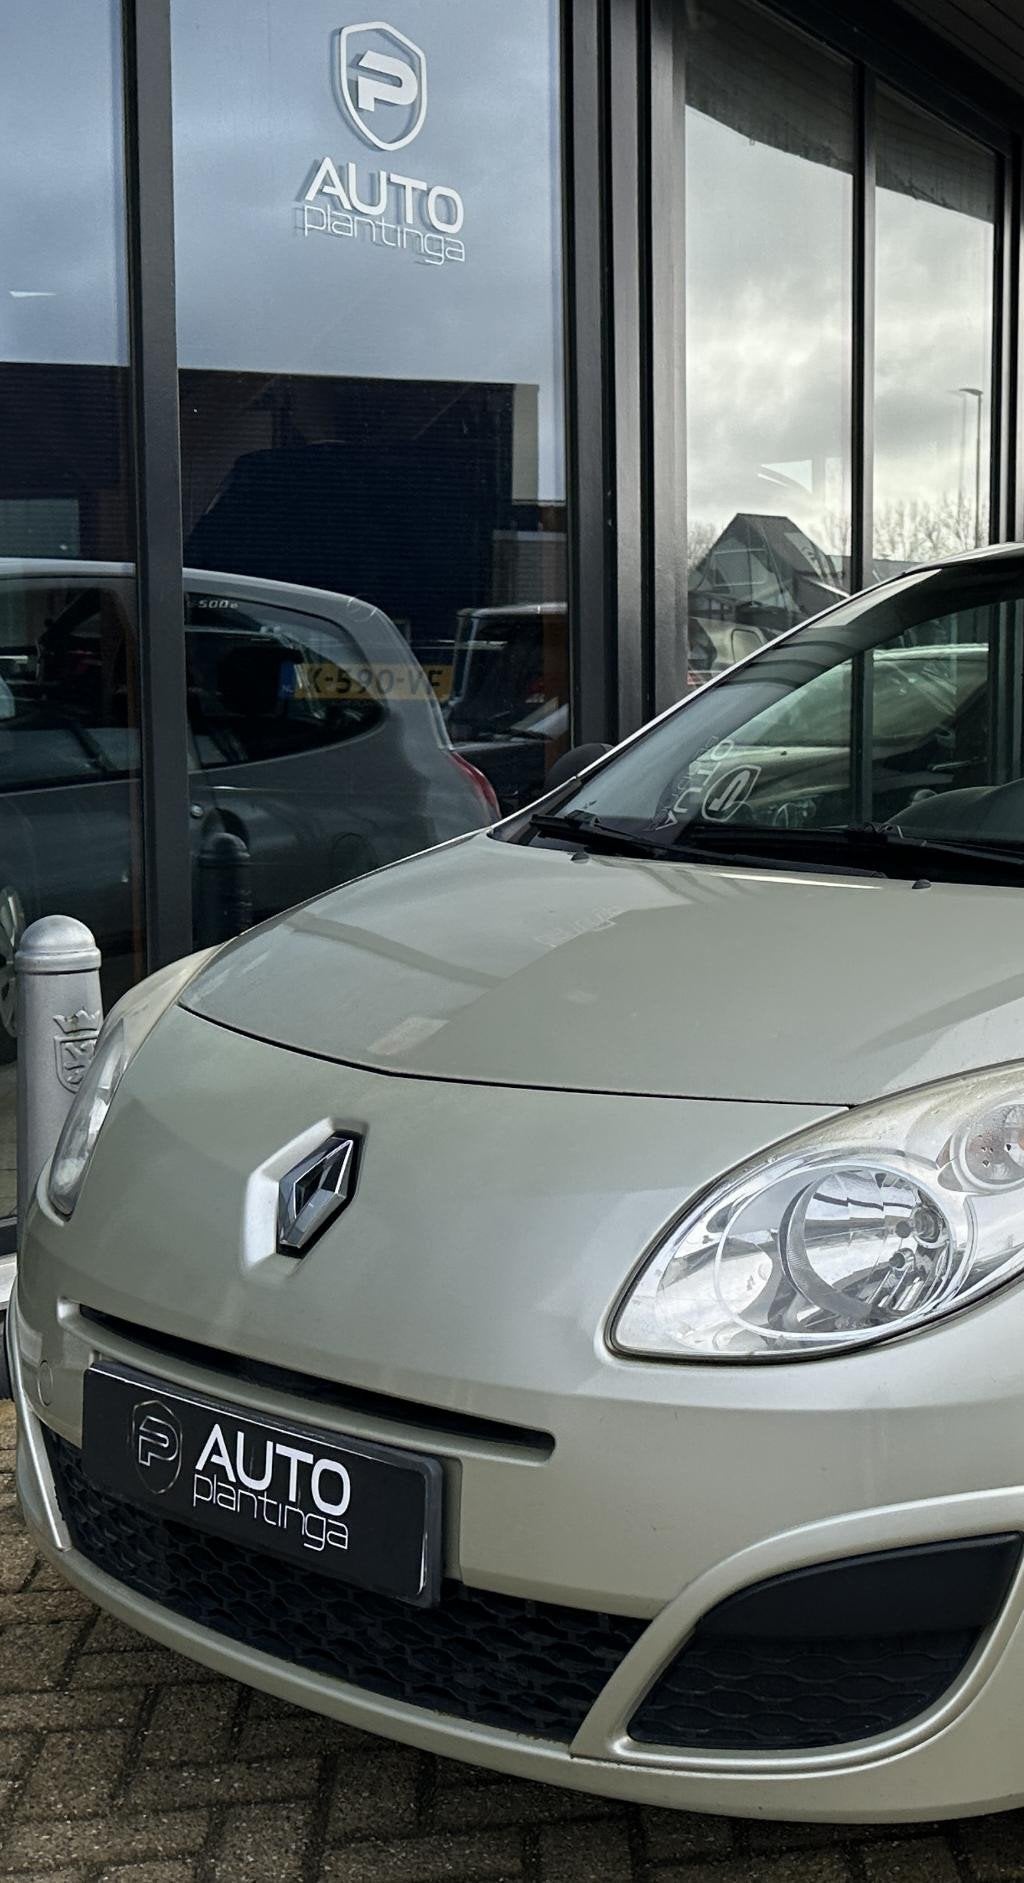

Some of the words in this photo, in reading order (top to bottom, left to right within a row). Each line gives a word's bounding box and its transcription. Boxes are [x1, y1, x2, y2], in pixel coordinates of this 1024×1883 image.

[304, 157, 464, 234] AUTO
[304, 204, 465, 266] plantinga
[195, 1424, 350, 1516] AUTO
[193, 1474, 348, 1551] plantinga
